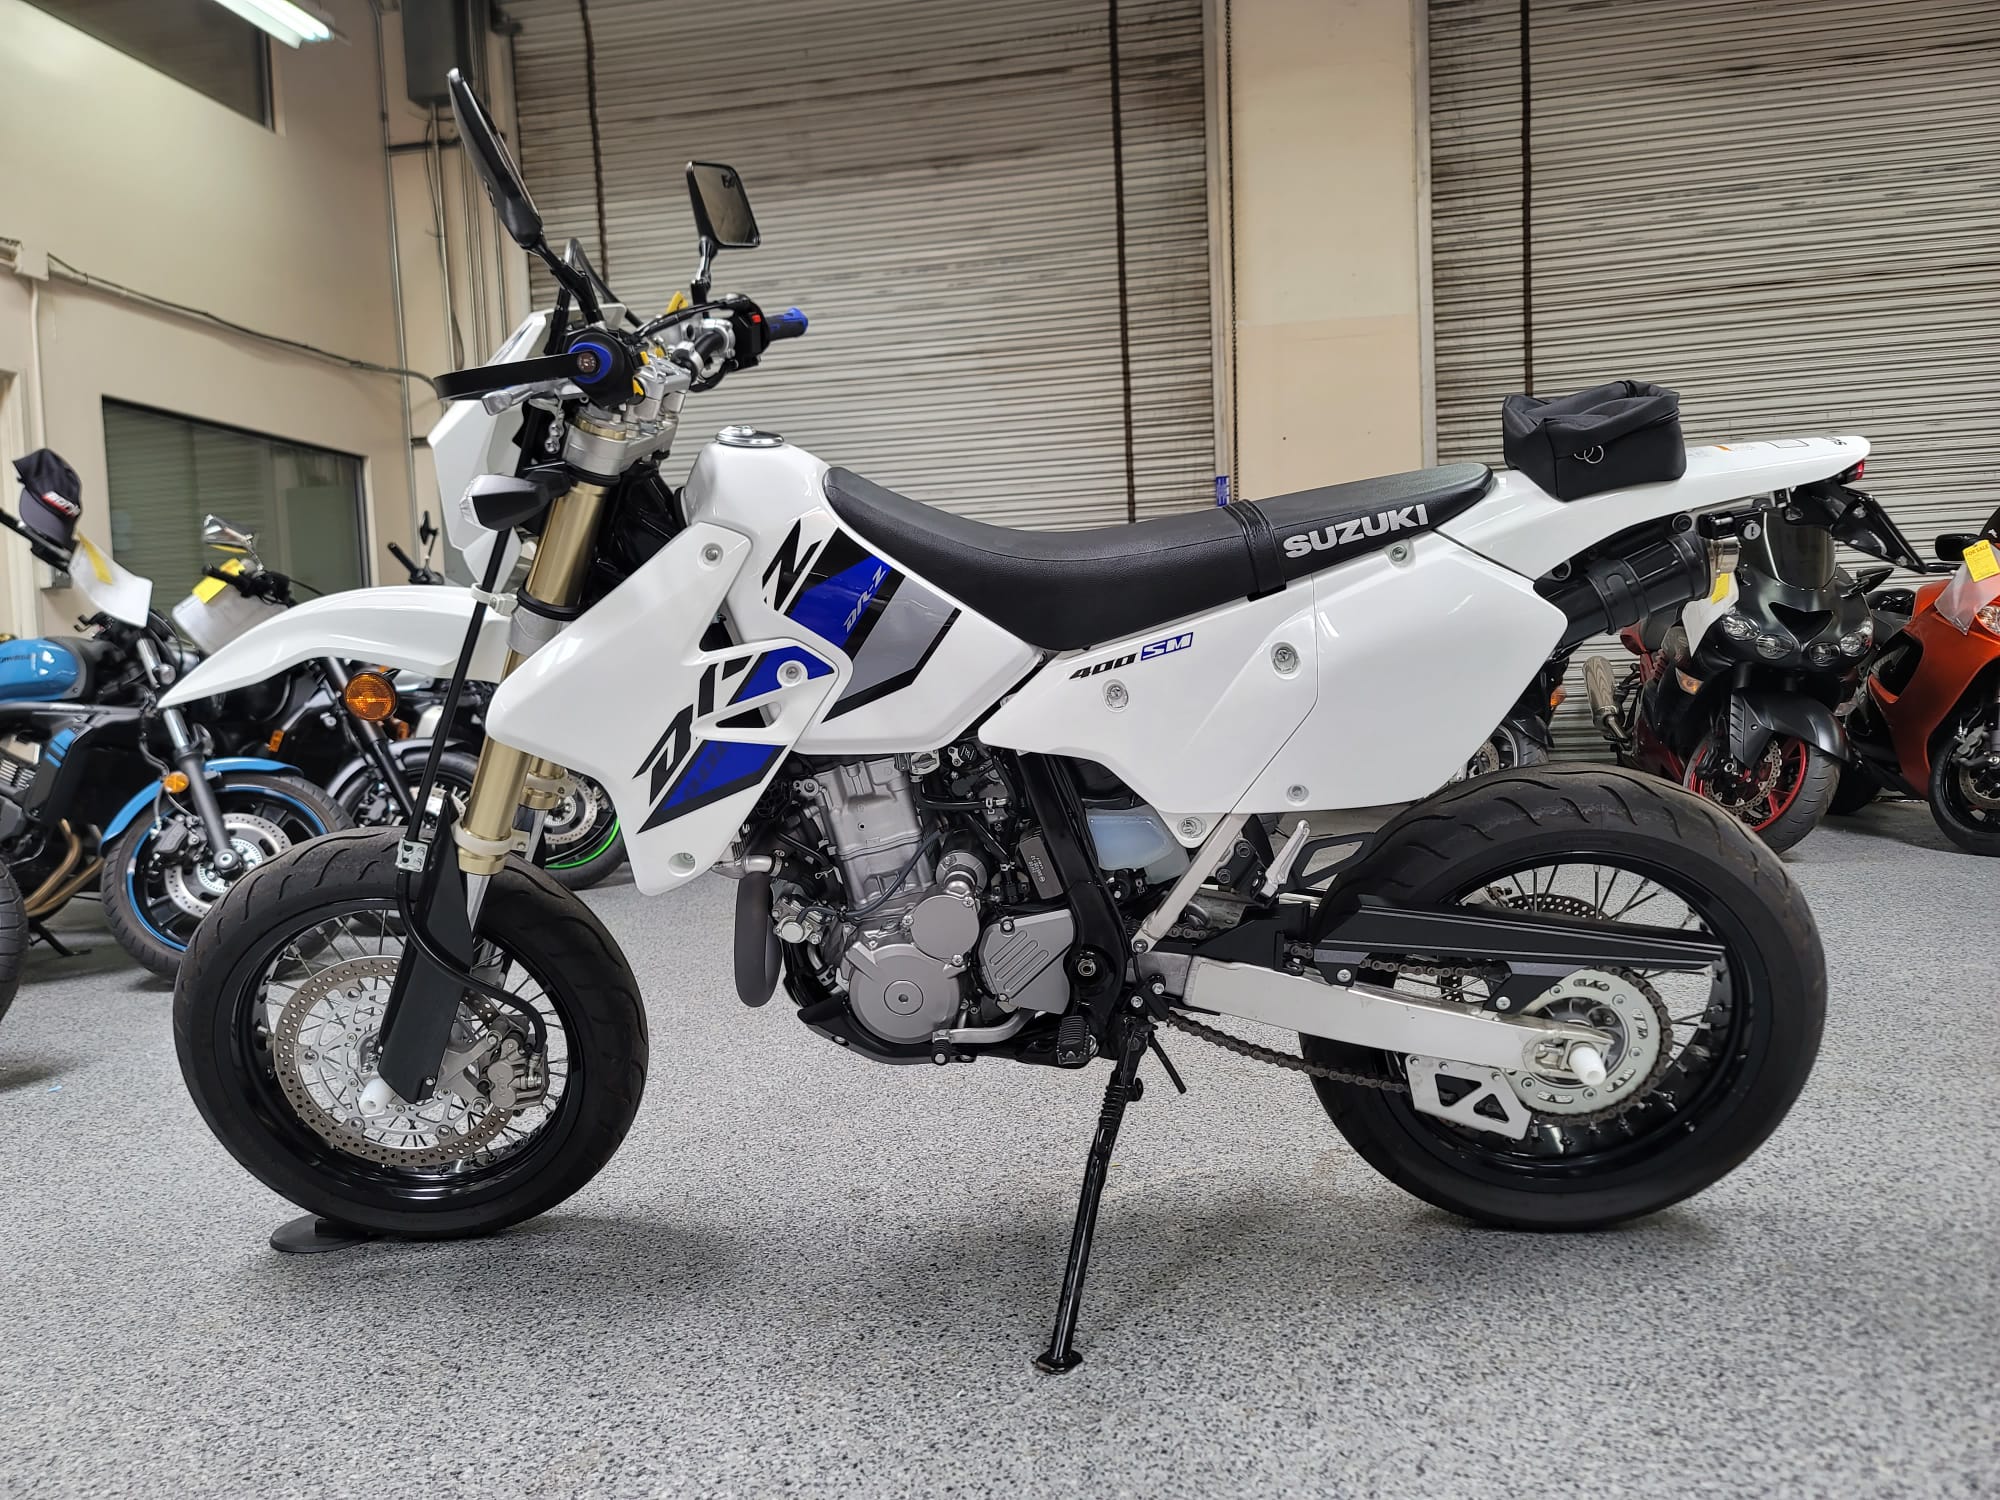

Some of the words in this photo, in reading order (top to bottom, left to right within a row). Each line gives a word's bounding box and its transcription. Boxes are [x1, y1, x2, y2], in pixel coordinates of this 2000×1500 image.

[1283, 504, 1429, 558] SUZUKI
[843, 565, 887, 633] DR-Z
[1069, 653, 1138, 680] 400
[1141, 632, 1194, 661] SM
